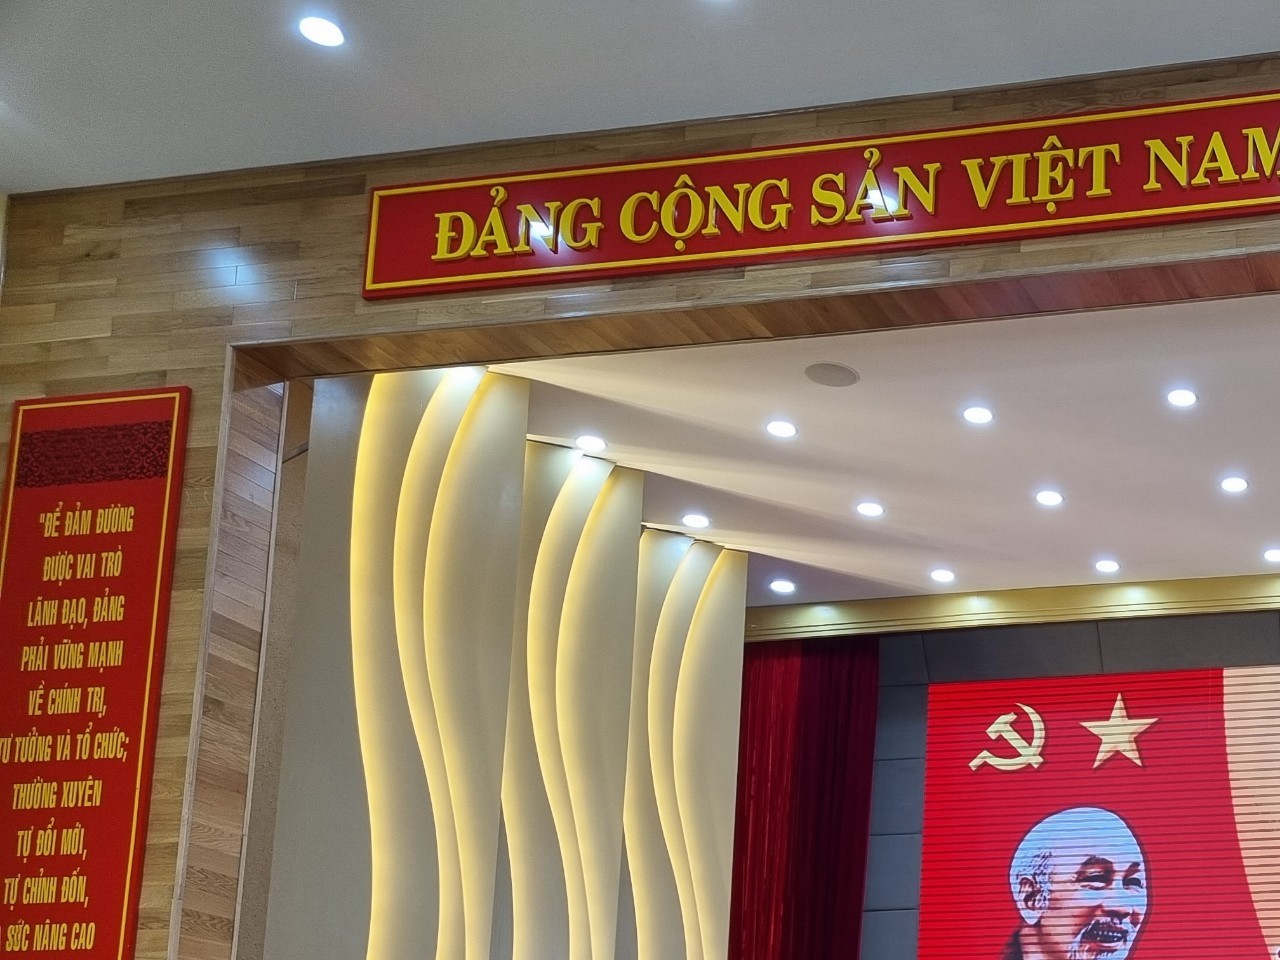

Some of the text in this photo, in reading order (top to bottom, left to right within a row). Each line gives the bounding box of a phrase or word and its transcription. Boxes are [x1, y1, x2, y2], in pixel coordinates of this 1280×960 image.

[431, 186, 604, 261] ĐẢNG
[619, 174, 793, 251] CỘNG
[810, 148, 942, 226] SẢN
[961, 135, 1120, 214] VIỆT
[64, 501, 92, 536] ĐẢM
[42, 545, 123, 586] ĐƯỢC VAI TRÒ
[27, 587, 125, 630] LÃNH ĐẠO, ĐẢNG
[20, 636, 124, 673] PHẢI VỮNG MẠNH
[28, 680, 107, 718] VỀ CHÍNH TRỊ,
[0, 733, 13, 763] TƯ
[14, 726, 52, 762] TƯỞNG
[56, 728, 71, 761] VÀ
[75, 721, 93, 760] TỔ
[12, 775, 103, 810] THƯỜNG XUYÊN
[16, 817, 87, 863] TỰ ĐỔI MỚI,
[3, 873, 20, 911] TỰ
[22, 868, 57, 905] CHỈNH
[5, 918, 95, 951] SỨC NÂNG CAO
